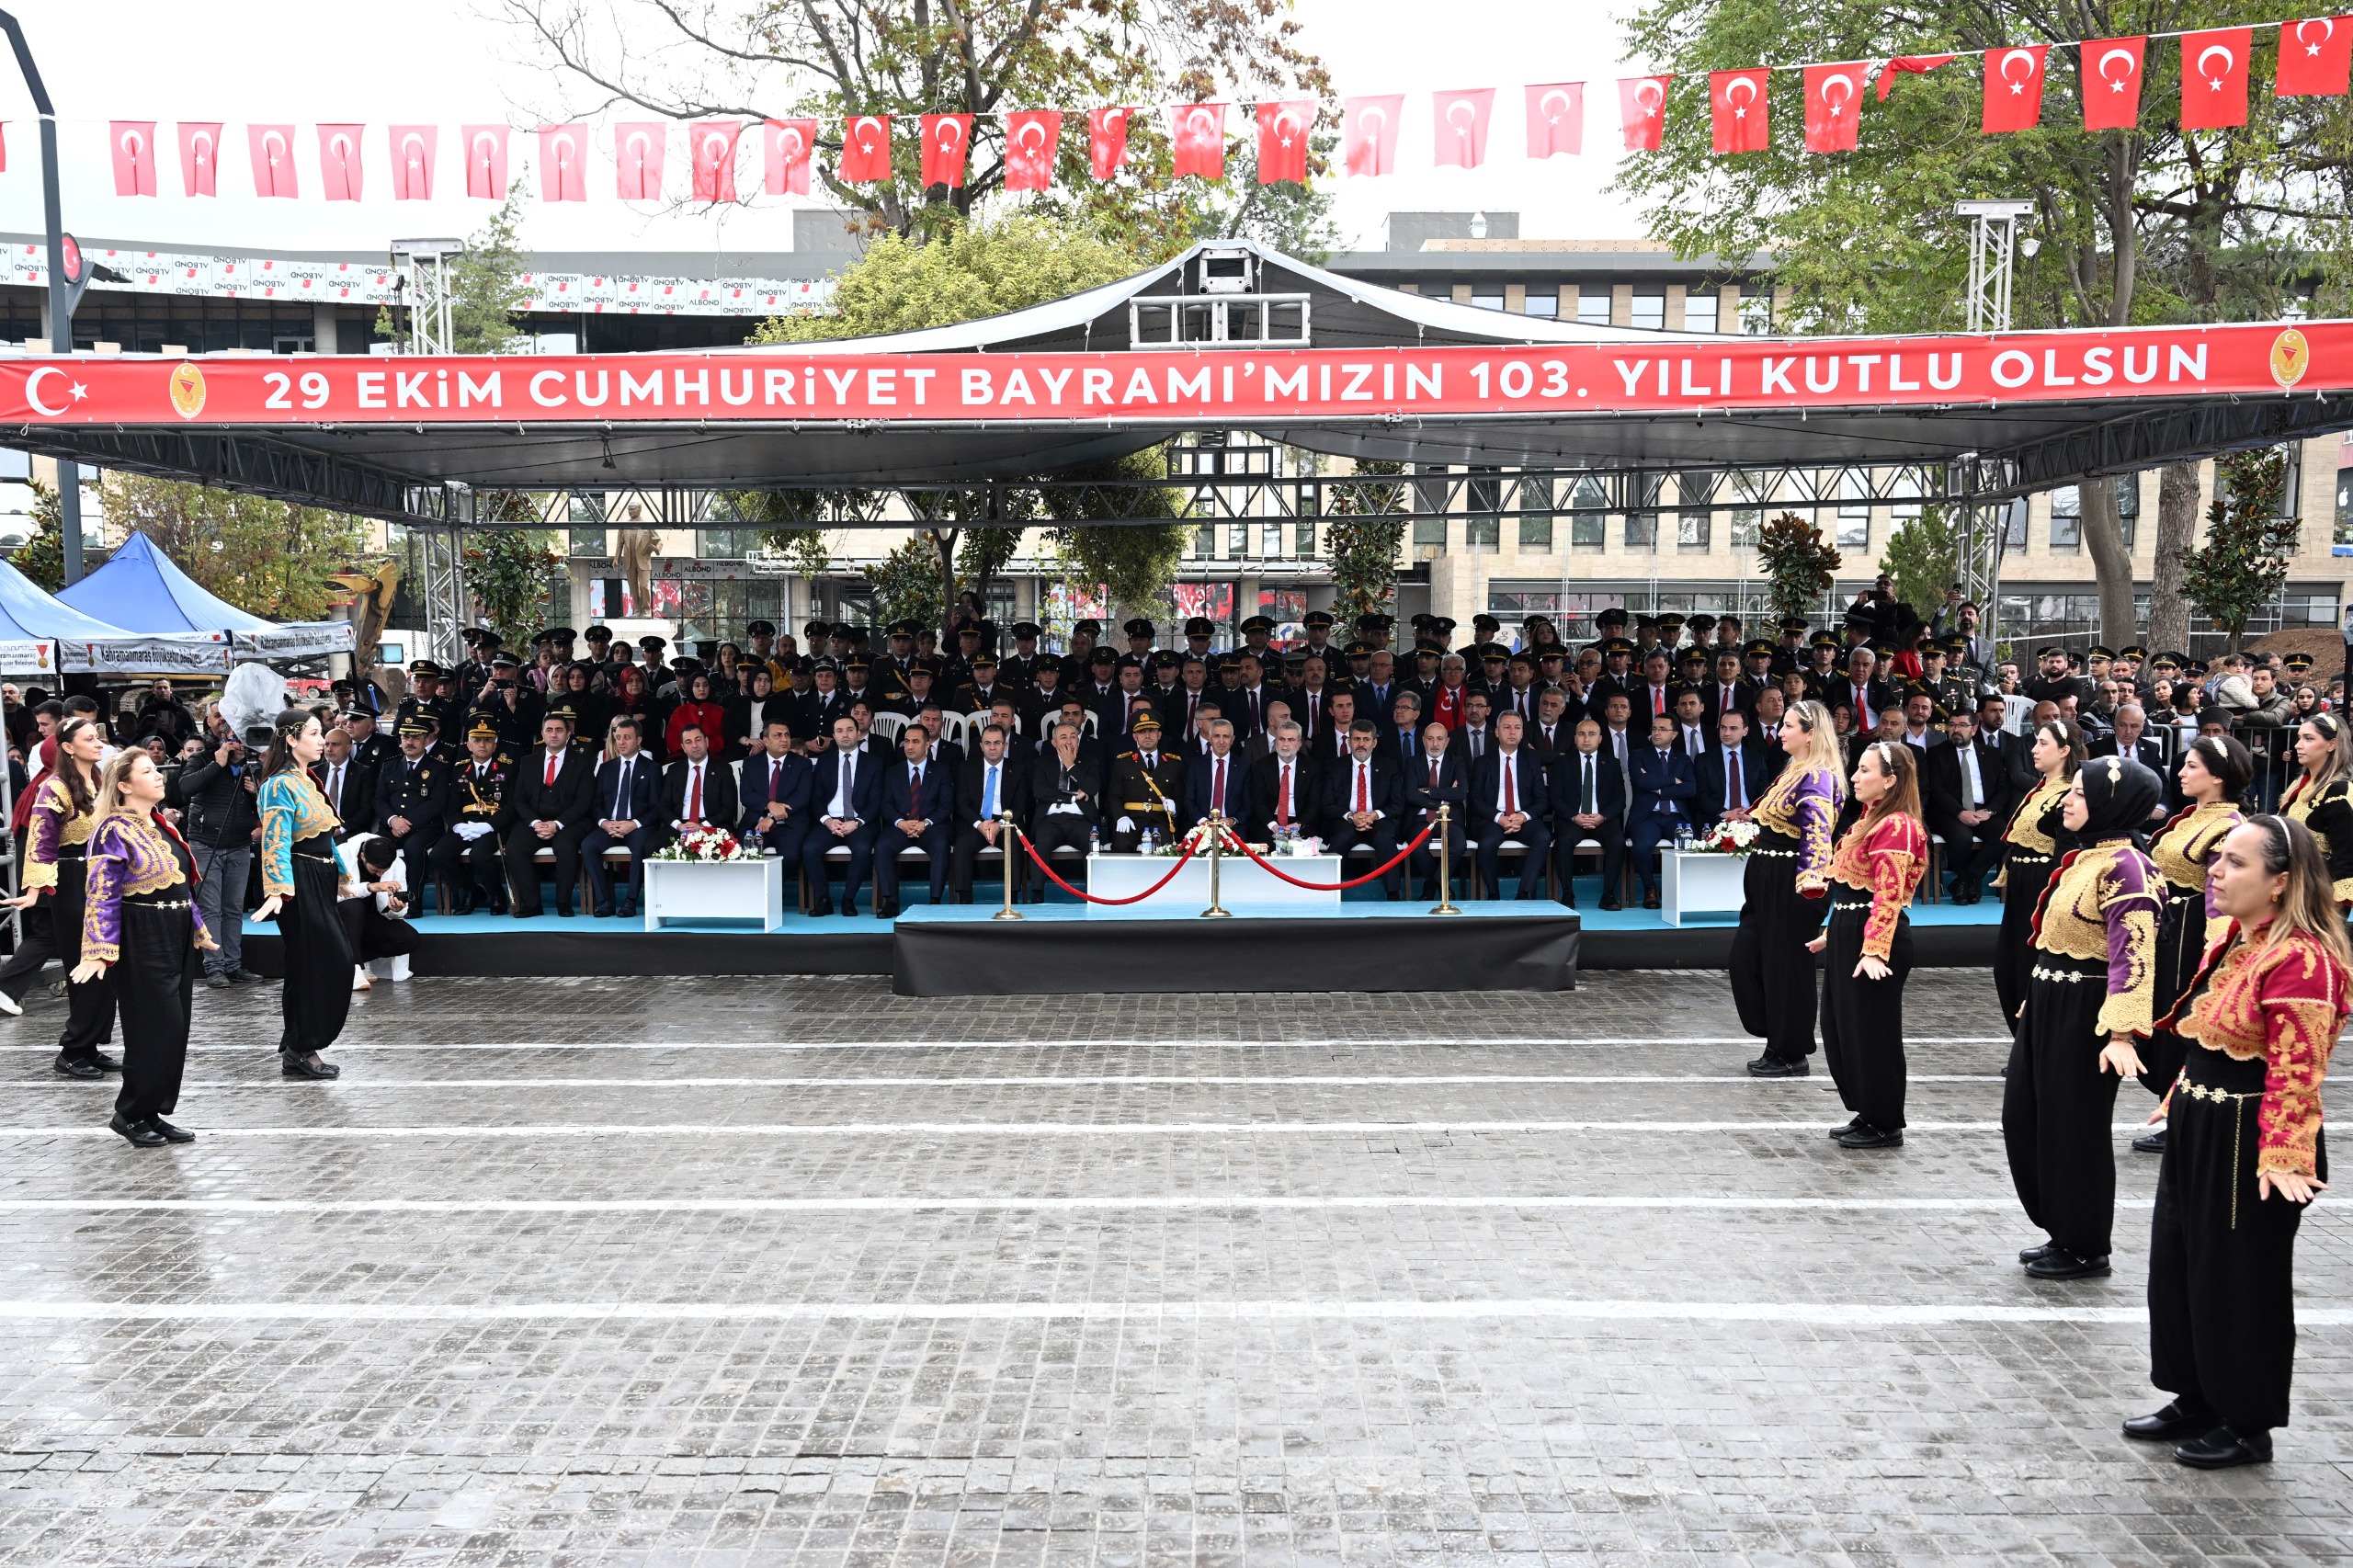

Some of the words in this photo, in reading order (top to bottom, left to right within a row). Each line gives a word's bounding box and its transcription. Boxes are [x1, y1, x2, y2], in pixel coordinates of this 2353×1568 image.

[176, 287, 210, 295] ALBOND
[214, 282, 248, 290] ALBOND
[263, 371, 330, 409] 29
[1469, 359, 1588, 399] 103.
[1612, 358, 1732, 396] YILI
[1762, 352, 1962, 394] KUTLU
[1990, 343, 2208, 388] OLSUN
[100, 645, 152, 666] Kahramanmaraş
